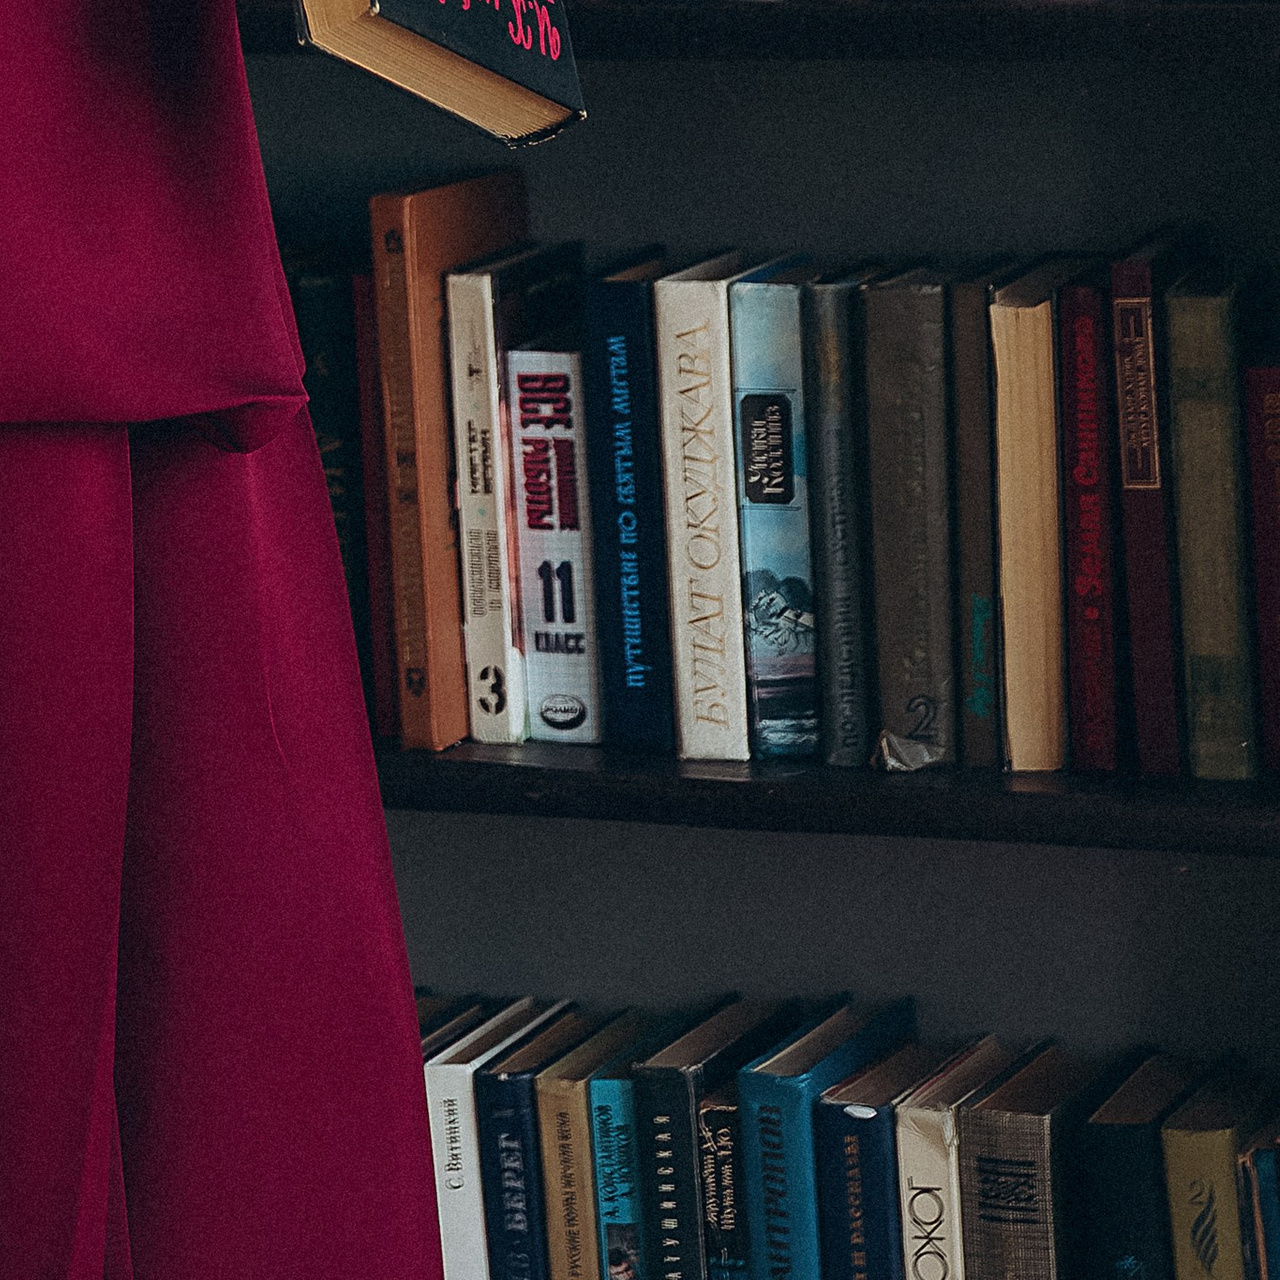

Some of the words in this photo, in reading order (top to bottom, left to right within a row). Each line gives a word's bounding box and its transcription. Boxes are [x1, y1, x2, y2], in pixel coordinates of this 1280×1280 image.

[517, 371, 574, 430] ВСЕ
[674, 320, 723, 570] ОКУДЖАВА
[520, 436, 555, 530] РАБОТЫ
[617, 511, 638, 544] ПО
[537, 560, 576, 623] 11
[1074, 493, 1103, 596] Земля
[619, 550, 654, 688] ПУТЕШЕСТВИЕ
[686, 574, 731, 731] БУЛАТ
[477, 664, 508, 717] 3
[905, 693, 939, 744] 2
[497, 1132, 529, 1233] БЕРЕГ
[653, 1115, 682, 1280] АТУШИНСКАЯ
[843, 1134, 865, 1245] РАССКАЗЫ
